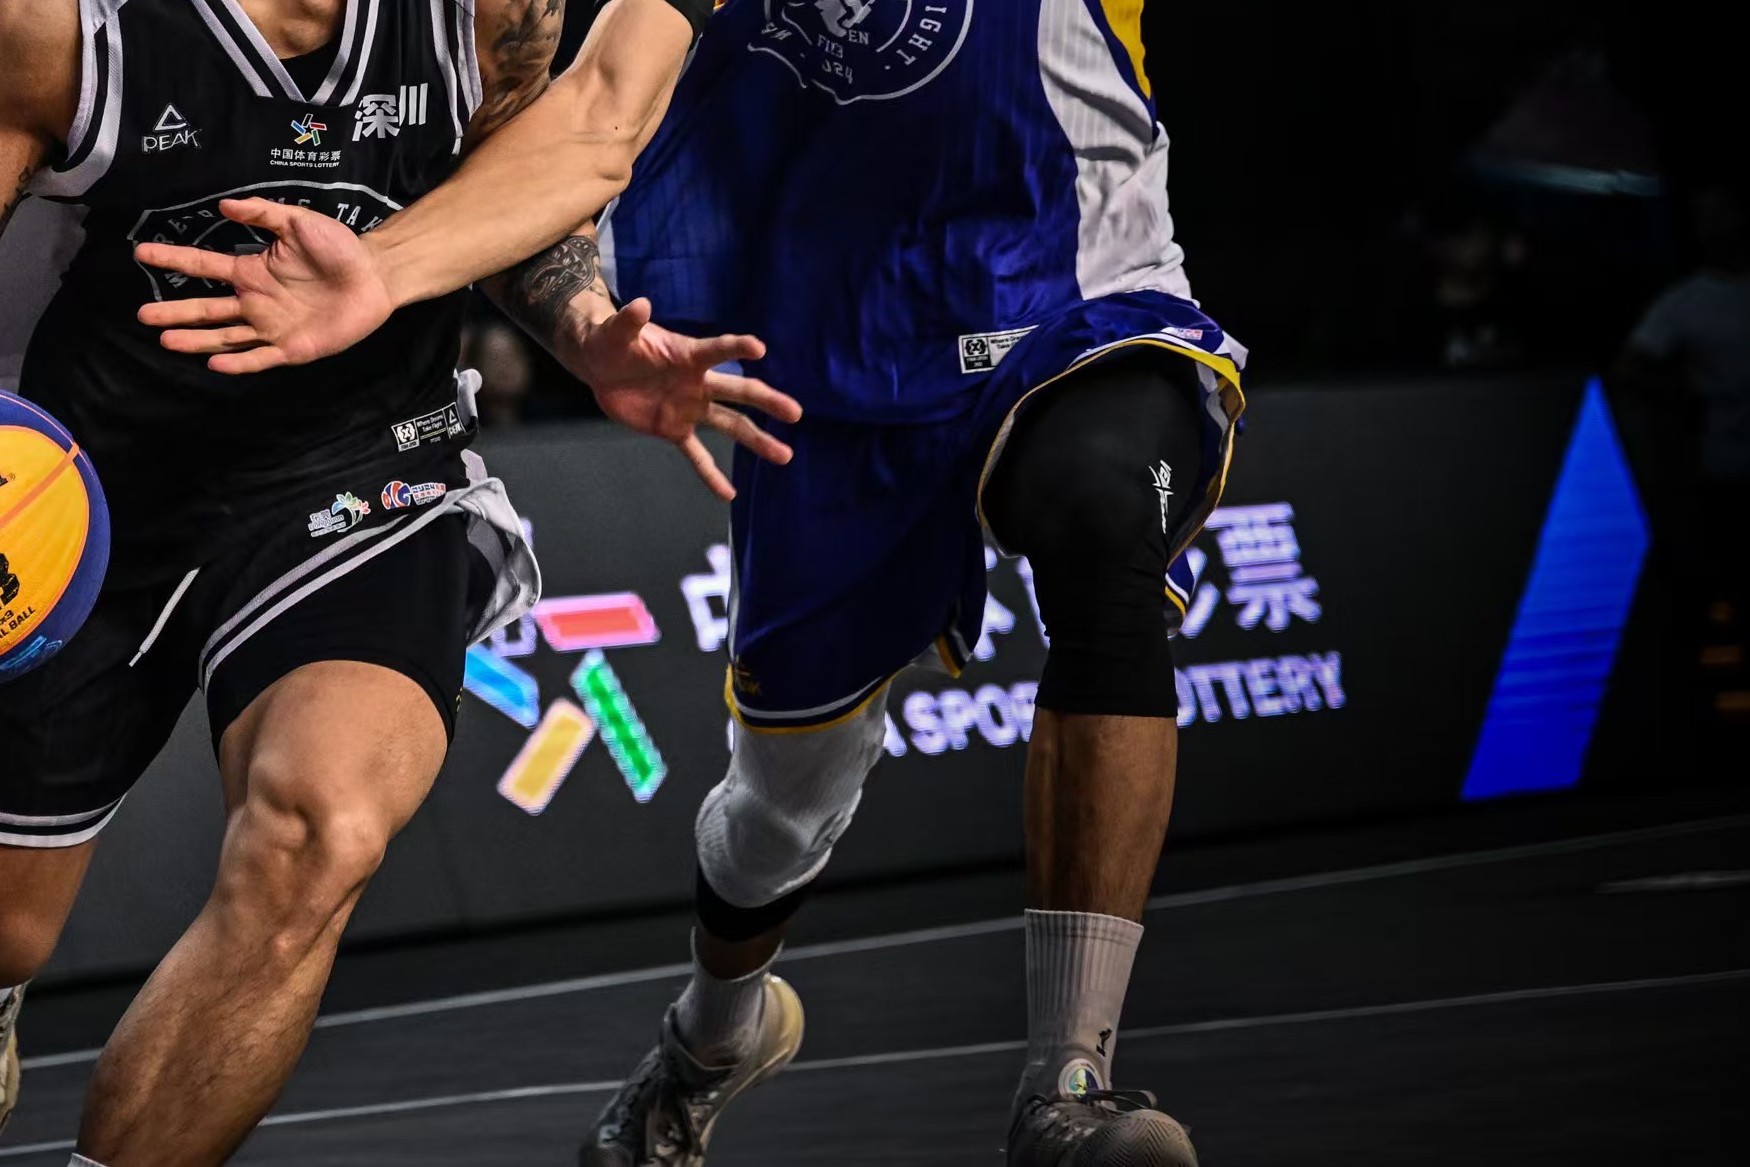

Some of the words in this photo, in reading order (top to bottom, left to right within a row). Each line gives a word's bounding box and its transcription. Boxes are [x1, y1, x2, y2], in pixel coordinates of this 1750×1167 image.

[142, 129, 199, 153] PEAK
[270, 147, 342, 162] 中国体育彩票
[270, 159, 289, 167] CHINA
[336, 202, 384, 232] TAK
[8, 605, 36, 631] BALL
[903, 682, 1038, 755] SPOR
